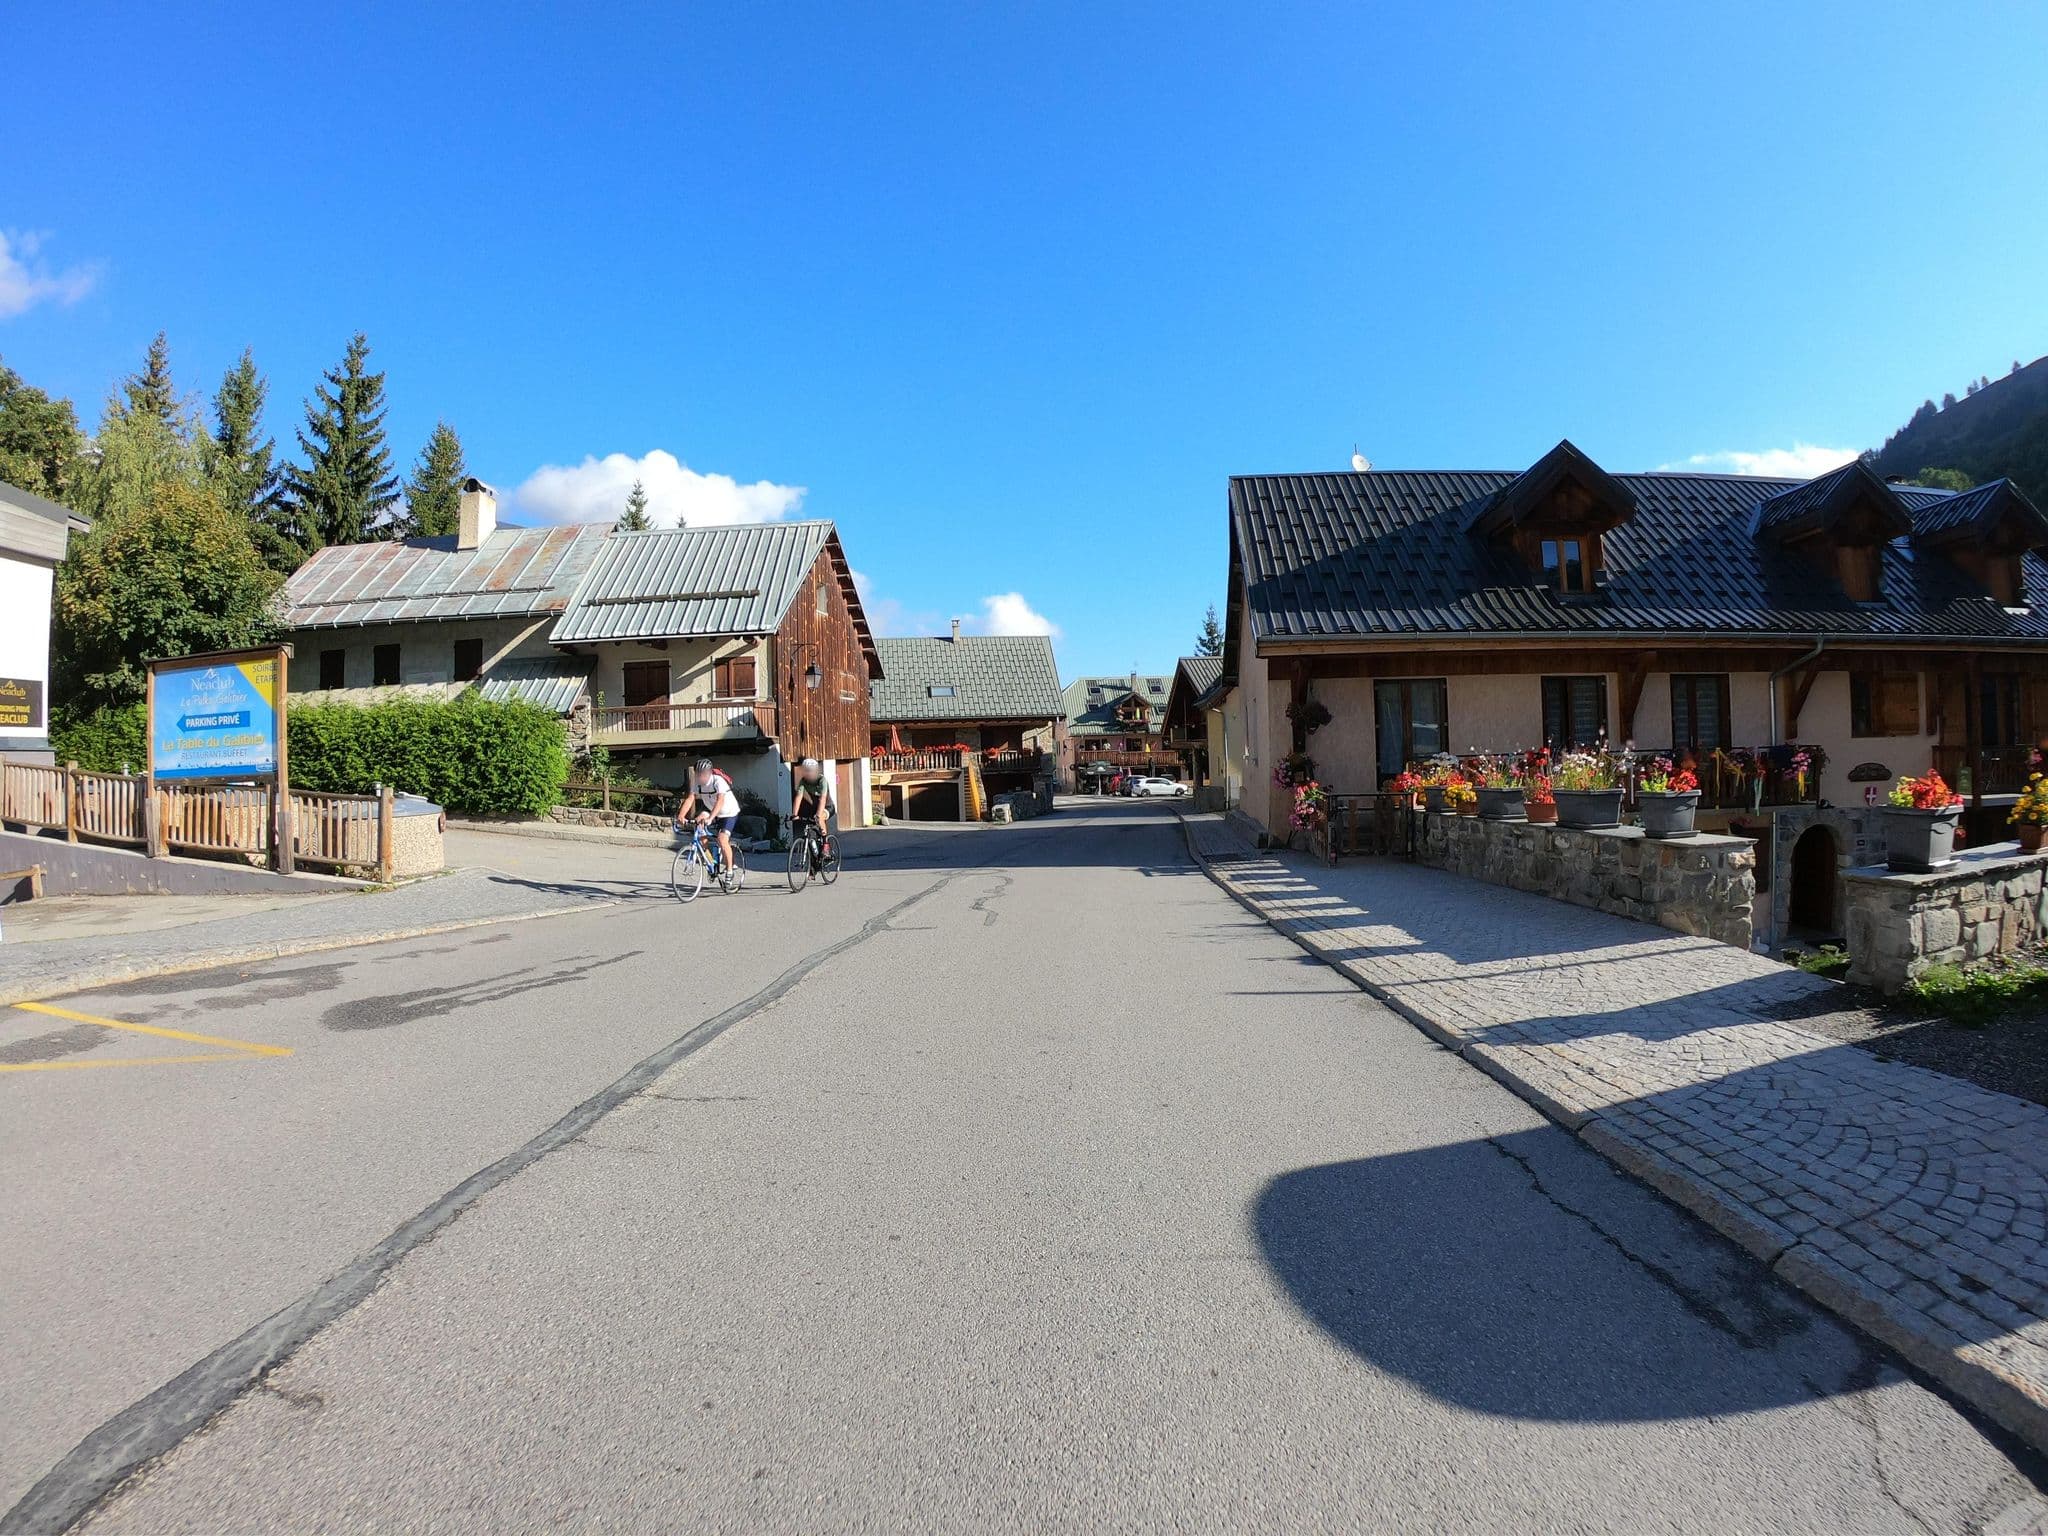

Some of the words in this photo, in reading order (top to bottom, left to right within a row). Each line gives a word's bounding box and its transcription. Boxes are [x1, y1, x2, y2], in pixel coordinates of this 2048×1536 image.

[191, 675, 235, 691] Neaclub
[185, 716, 217, 728] PARKING
[218, 713, 240, 725] PRIVÉ
[177, 737, 204, 750] Table
[207, 735, 219, 748] du
[181, 750, 222, 761] RESTAURANT
[222, 748, 248, 758] BUFFET
